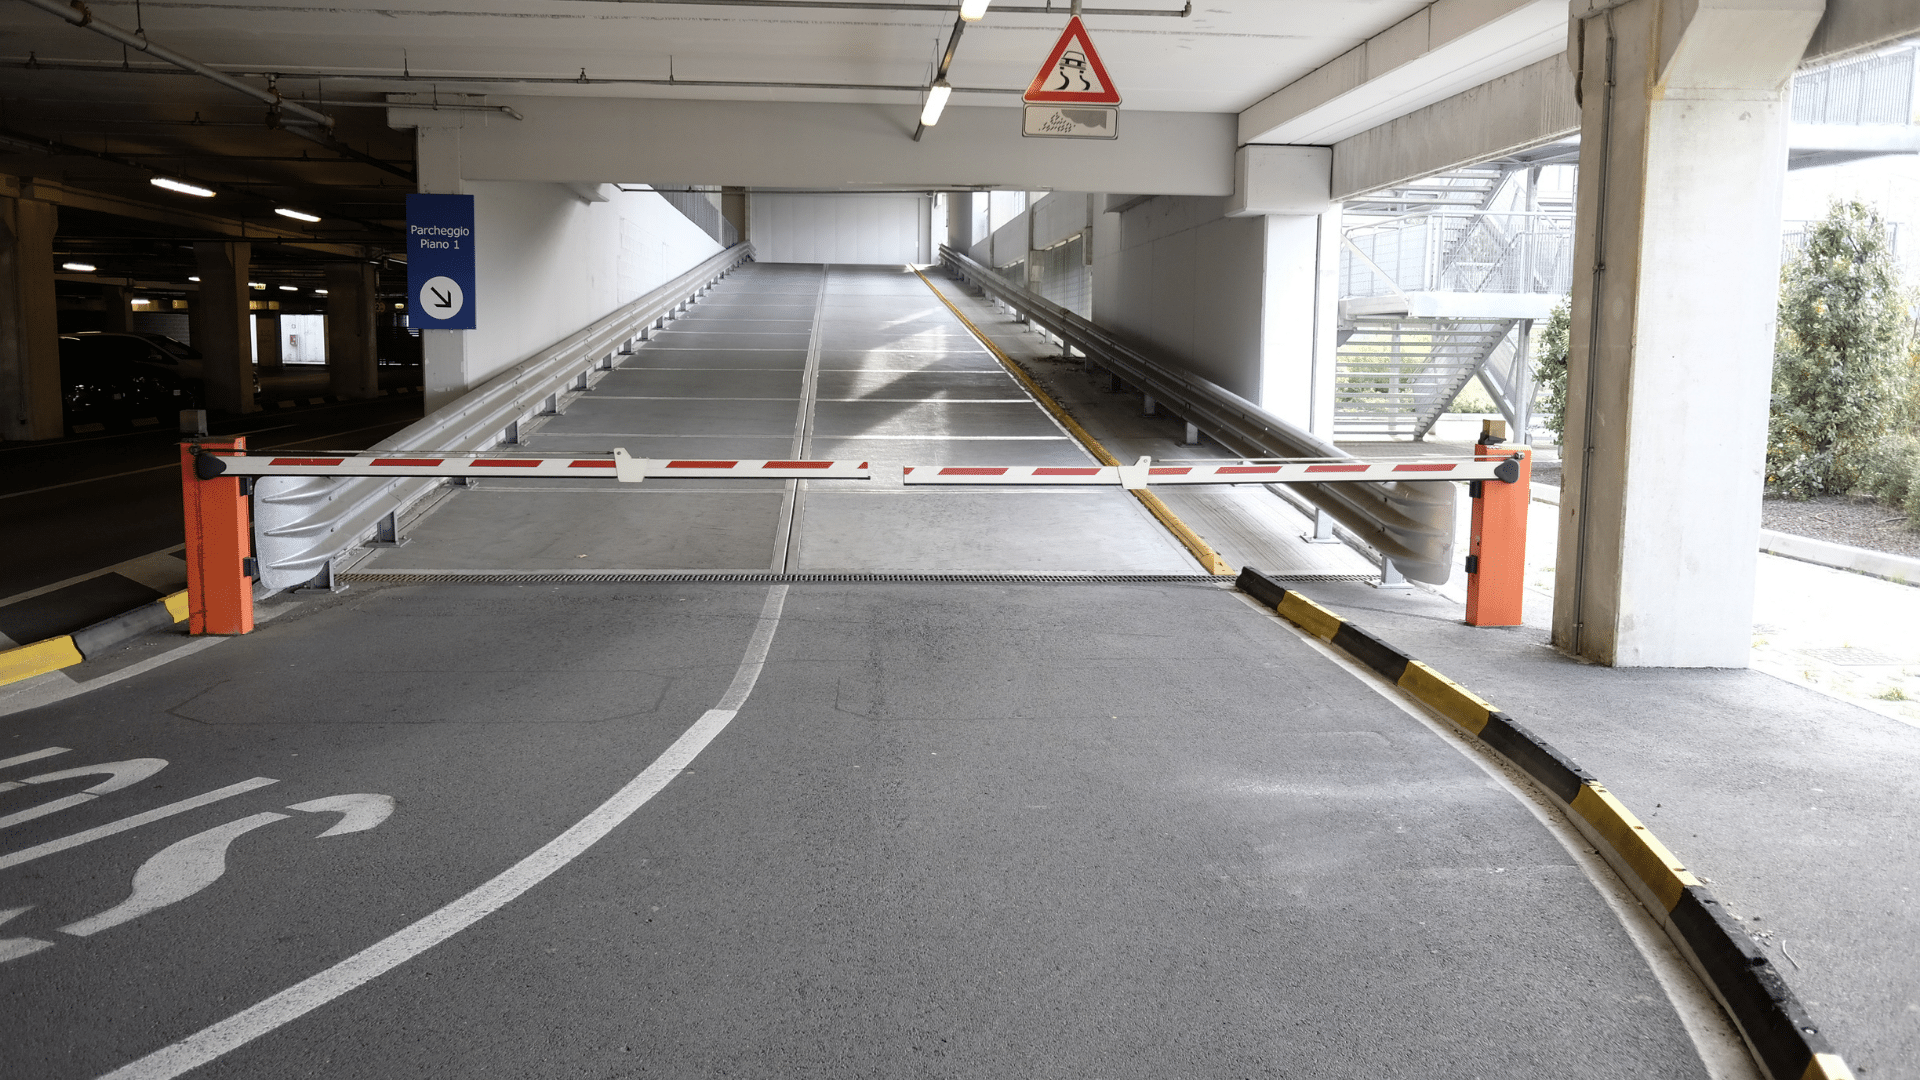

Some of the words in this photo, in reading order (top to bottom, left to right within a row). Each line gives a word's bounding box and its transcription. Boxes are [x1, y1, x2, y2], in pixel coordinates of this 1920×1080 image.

[410, 225, 470, 238] Parcheggio
[420, 239, 450, 249] Piano
[453, 240, 460, 250] 1
